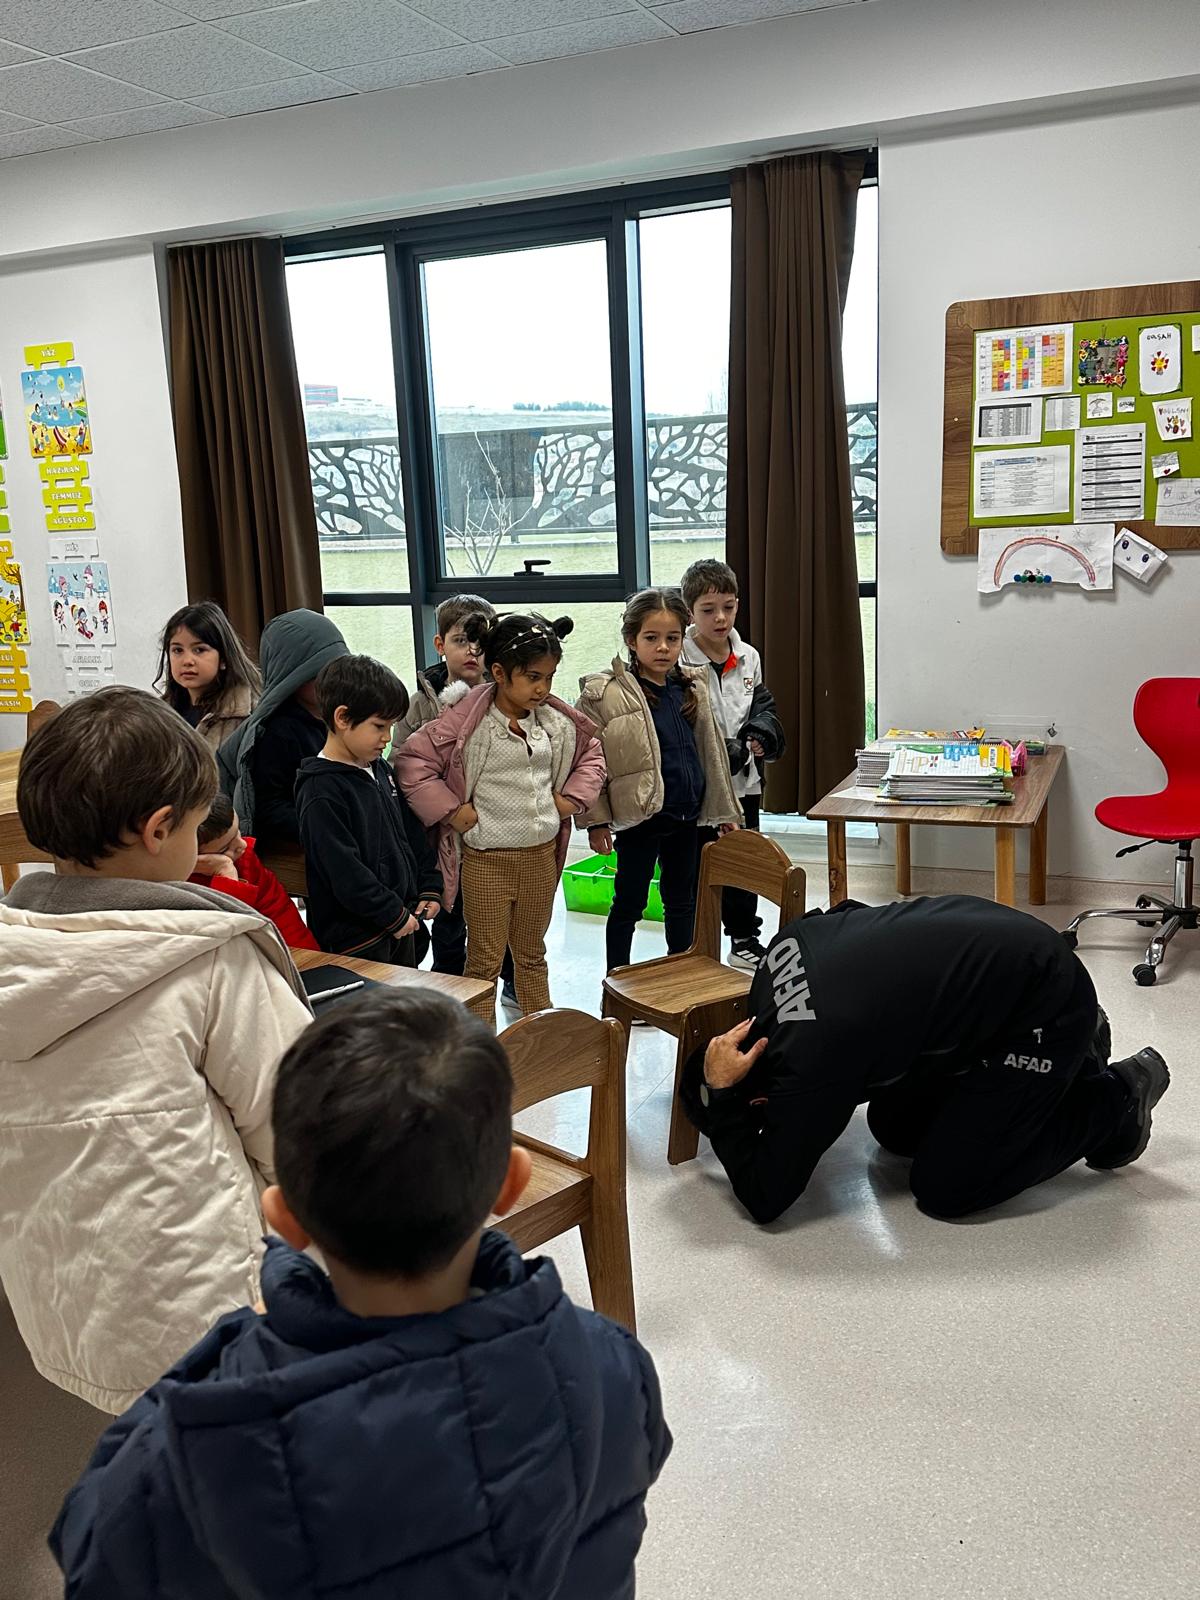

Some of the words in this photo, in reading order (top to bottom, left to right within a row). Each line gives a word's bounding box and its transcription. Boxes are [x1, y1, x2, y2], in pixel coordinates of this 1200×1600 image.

[41, 349, 56, 357] YAZ
[51, 492, 82, 500] TEMMUZ
[767, 937, 817, 1024] AFAD
[1003, 1053, 1053, 1073] AFAD
